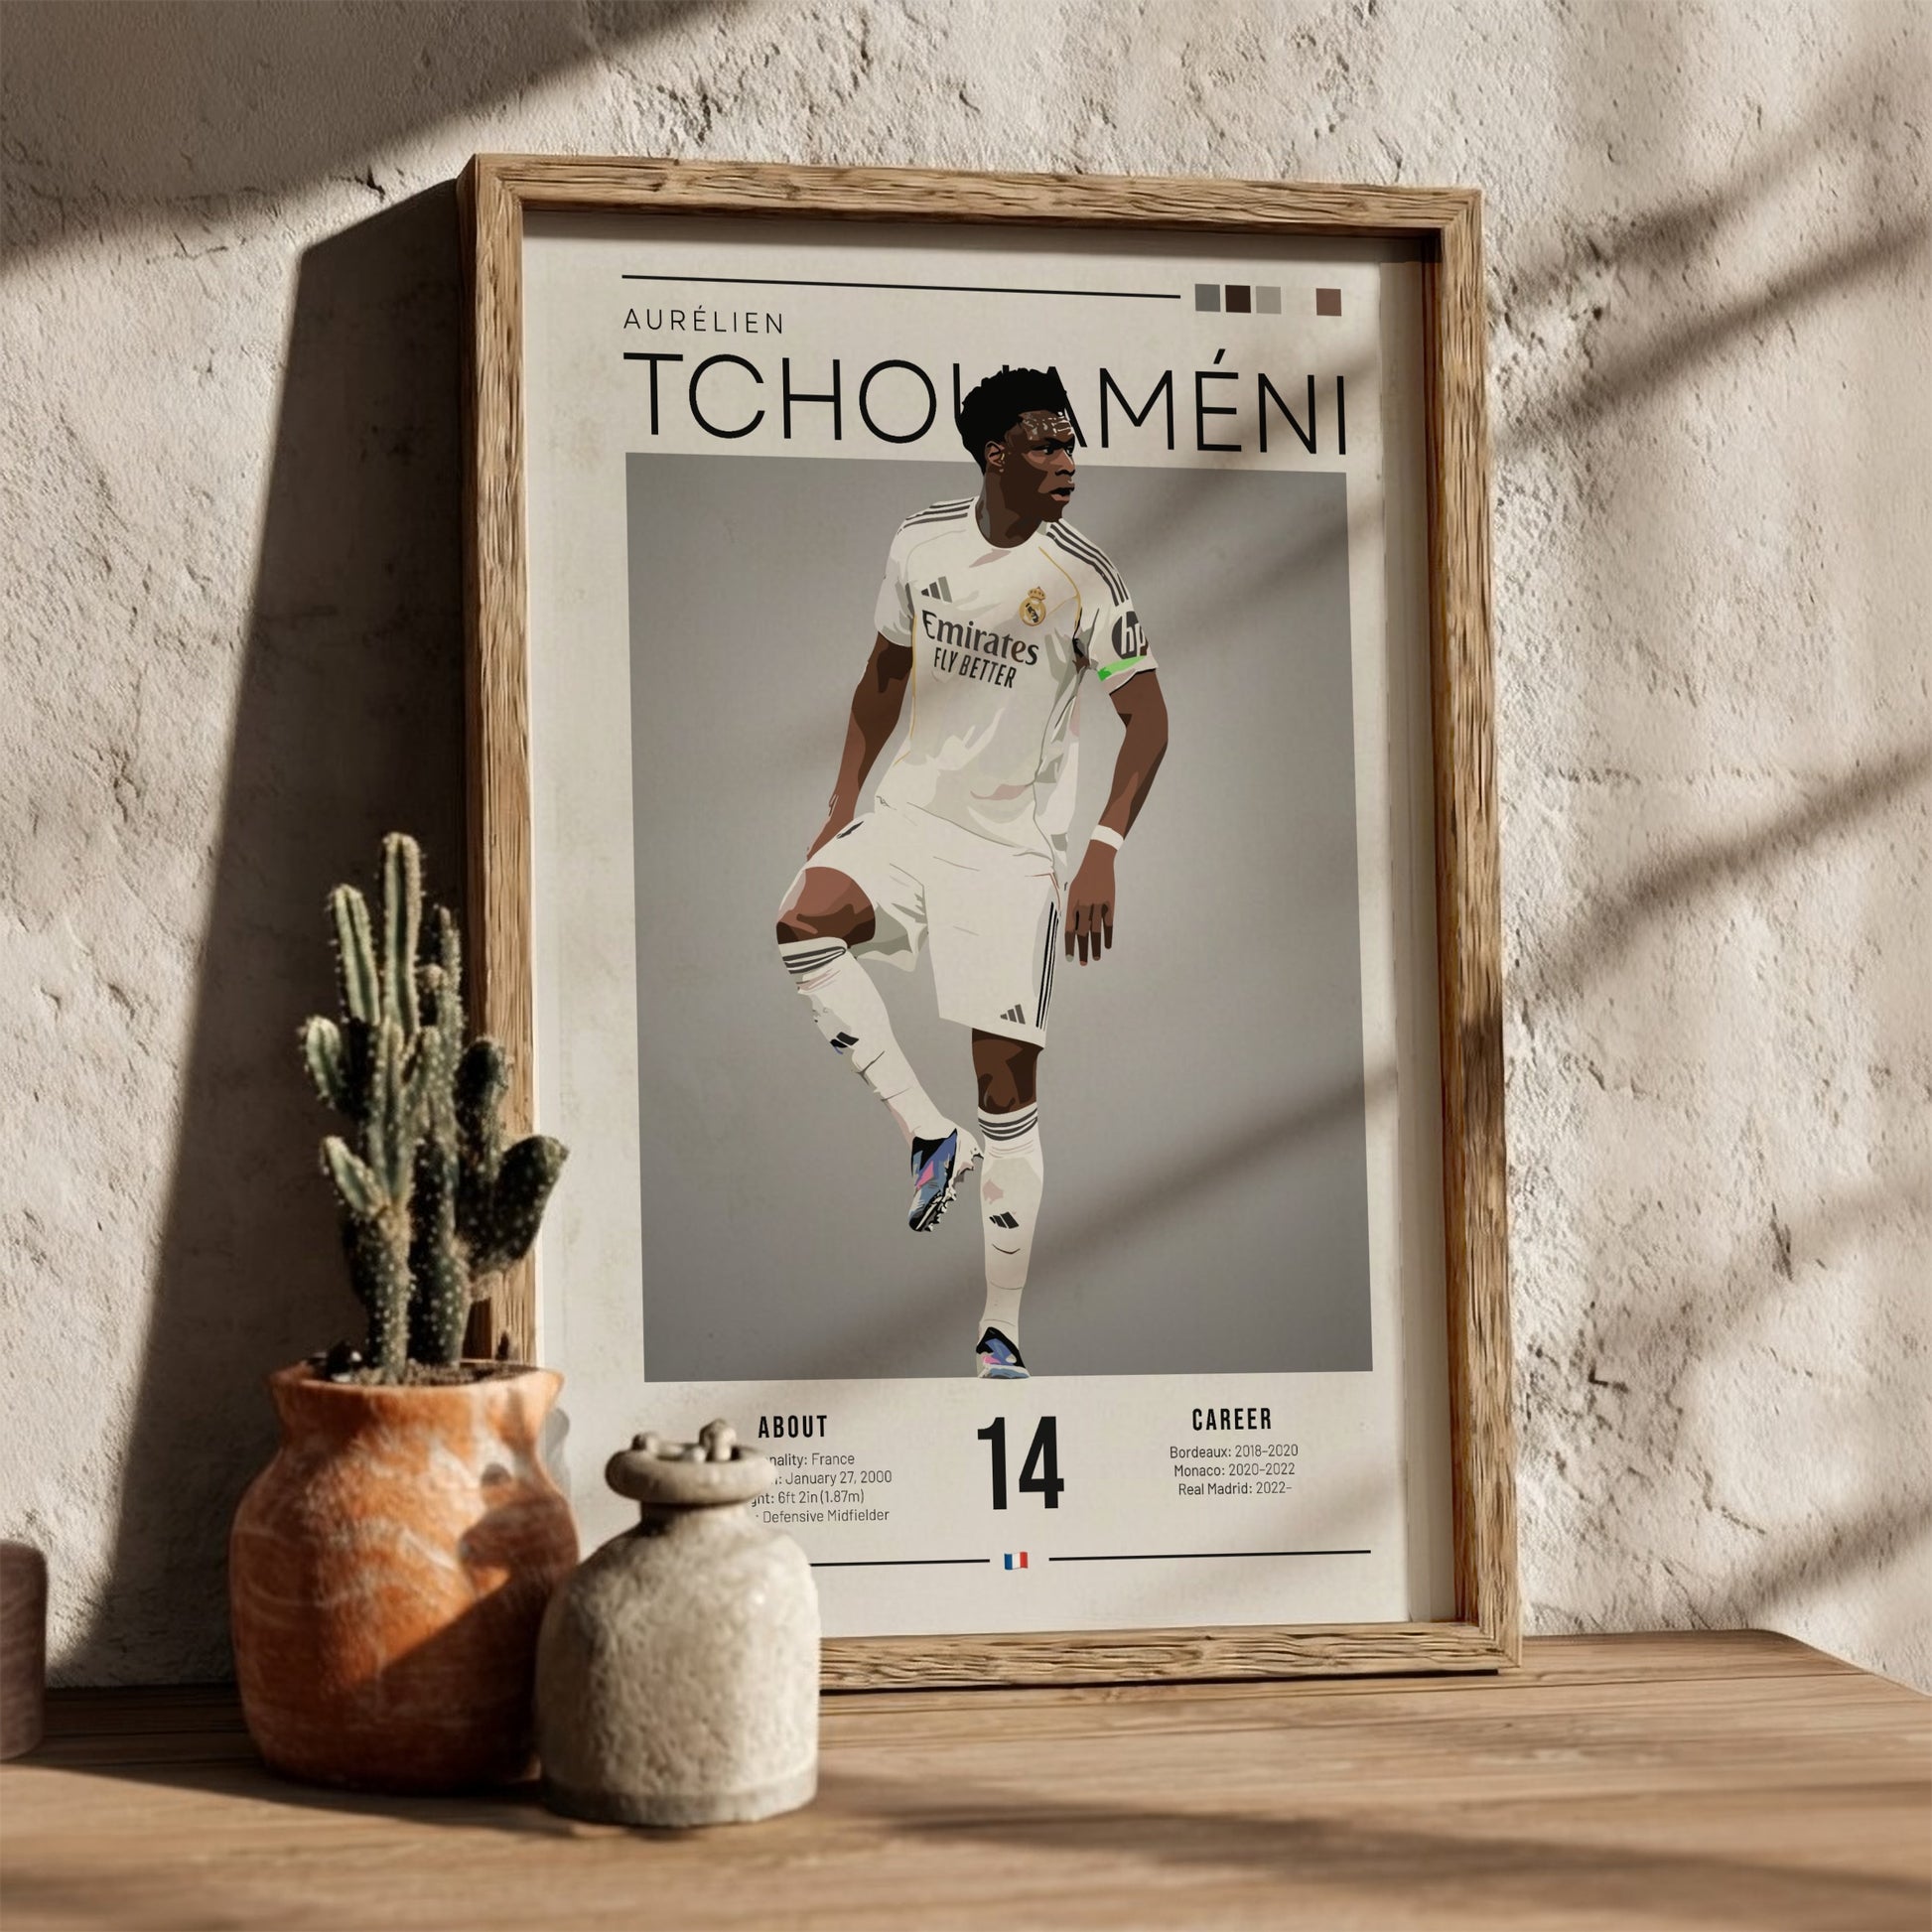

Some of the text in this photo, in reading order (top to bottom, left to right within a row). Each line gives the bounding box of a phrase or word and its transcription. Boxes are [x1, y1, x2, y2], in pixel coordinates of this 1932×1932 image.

[622, 304, 782, 335] AURÉLIEN
[921, 609, 1039, 666] Emirates
[1120, 614, 1147, 657] hp
[933, 646, 1018, 689] FLY BETTER
[758, 1414, 828, 1439] ABOUT
[1191, 1407, 1272, 1432] CAREER
[765, 1452, 856, 1469] nality: France
[1170, 1444, 1299, 1459] Bordeaux: 2018-2020
[977, 1415, 1065, 1511] 14
[1173, 1461, 1296, 1477] Monaco: 2020-2022
[784, 1472, 837, 1487] January
[839, 1470, 857, 1485] 27,
[860, 1469, 893, 1484] 2000
[1178, 1482, 1204, 1496] Real
[1207, 1481, 1253, 1495] Madrid:
[777, 1490, 796, 1504] 6ft
[762, 1509, 824, 1524] Defensive
[827, 1508, 891, 1522] Midfielder
